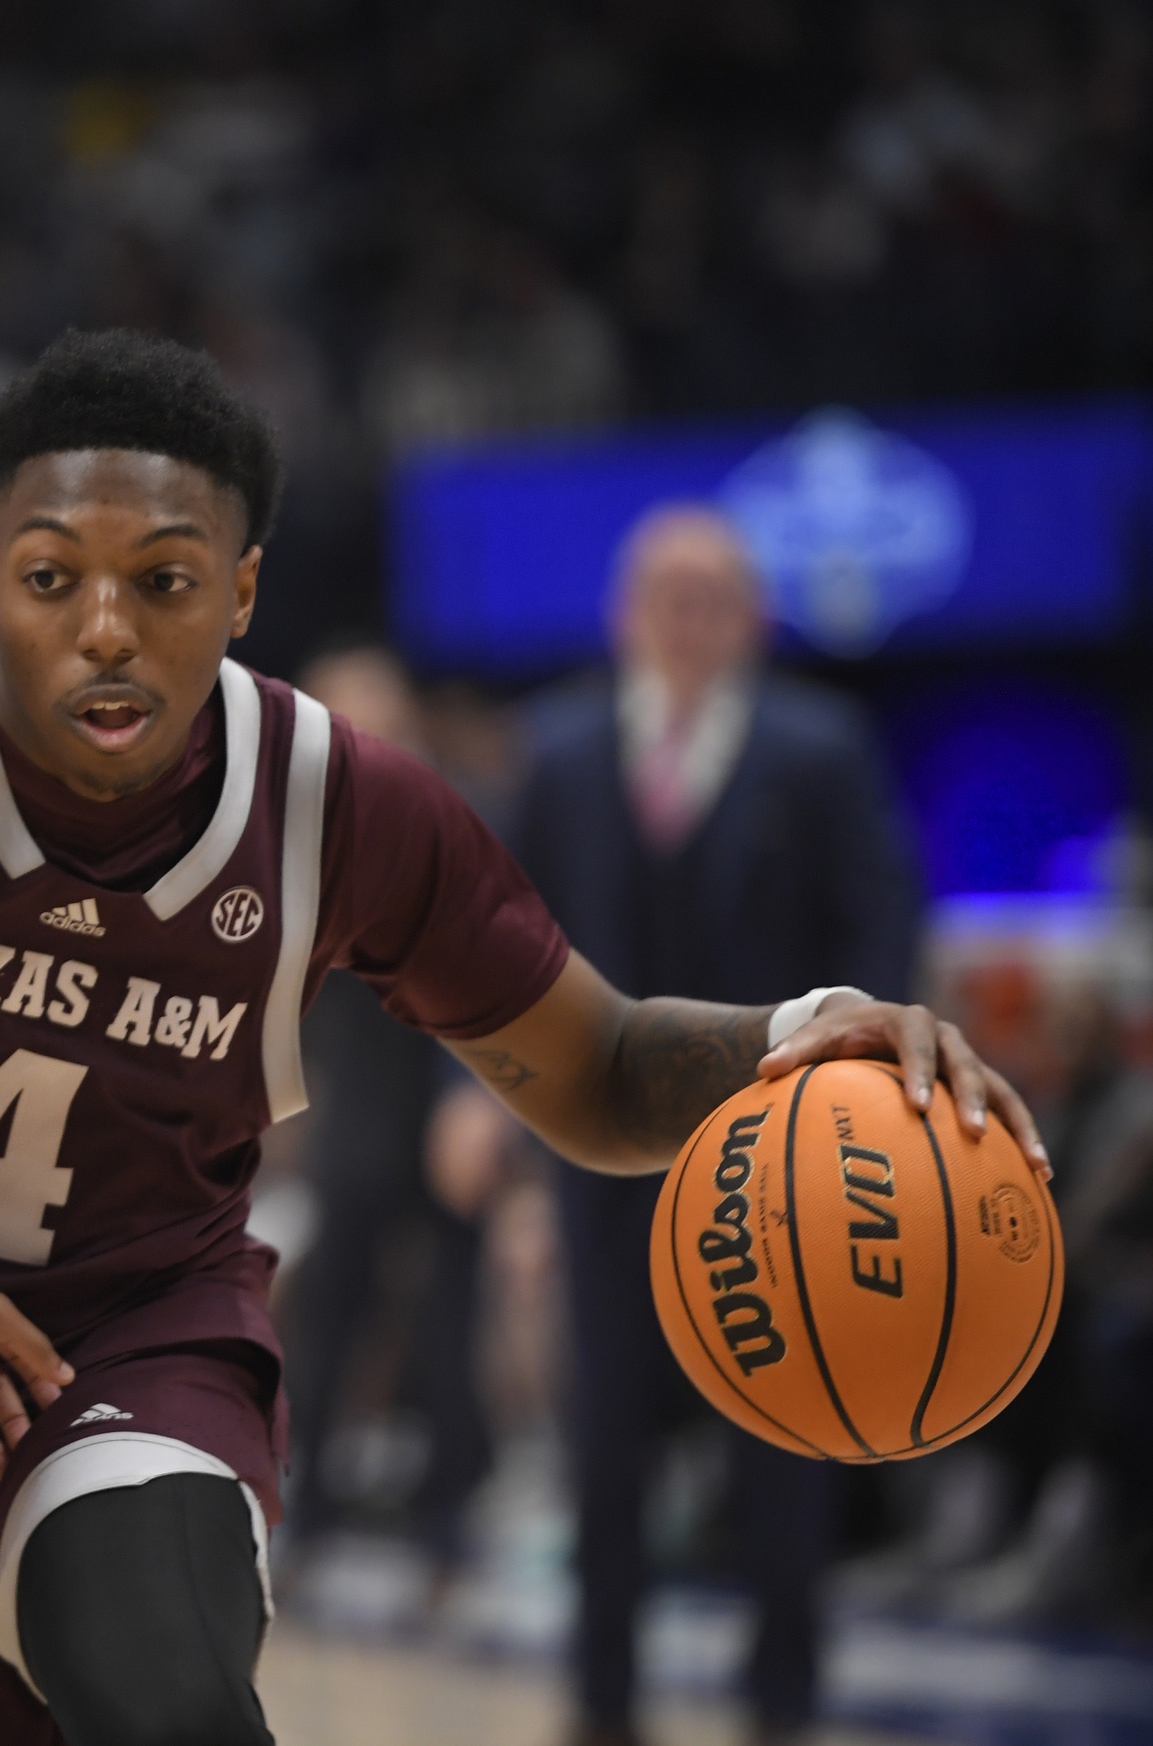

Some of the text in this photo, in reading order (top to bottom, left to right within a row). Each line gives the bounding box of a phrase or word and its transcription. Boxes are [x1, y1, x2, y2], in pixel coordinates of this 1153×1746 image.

[40, 911, 106, 937] adidas
[212, 889, 263, 940] SEC
[105, 975, 248, 1060] A&M
[831, 1103, 855, 1142] NXT
[698, 1107, 787, 1378] Wilson
[839, 1143, 904, 1299] EVO
